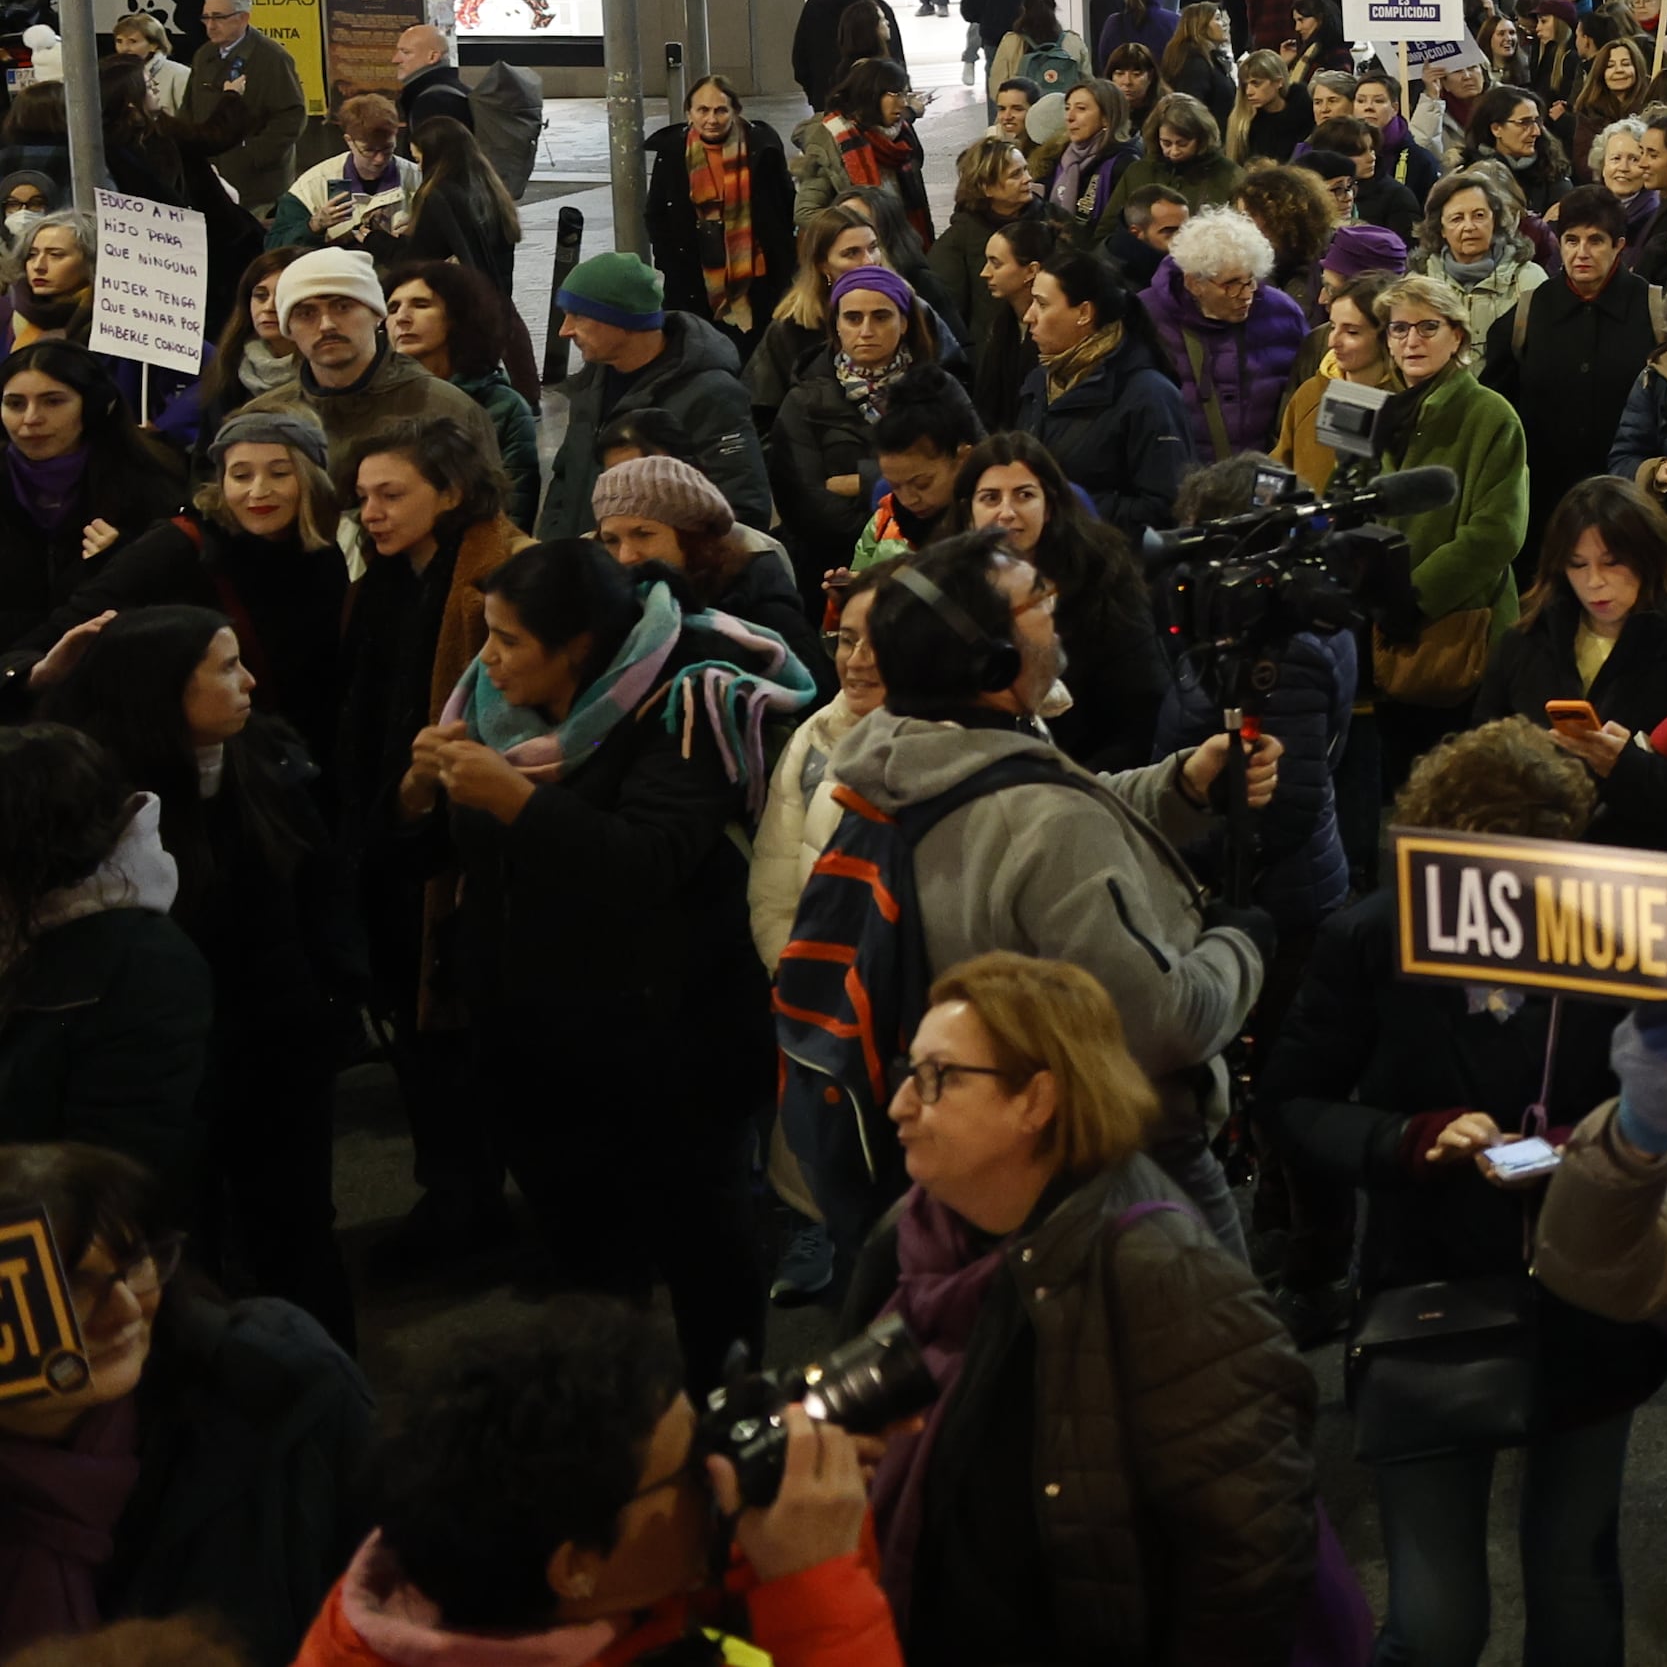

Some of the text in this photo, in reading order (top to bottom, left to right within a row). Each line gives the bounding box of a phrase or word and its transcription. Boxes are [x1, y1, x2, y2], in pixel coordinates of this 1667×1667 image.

[1372, 6, 1436, 19] COMPLICIDAD
[99, 192, 162, 218] EDUCO A
[146, 227, 183, 249] PARA
[104, 243, 130, 260] QUE
[101, 276, 196, 311] MUJER TENGA
[101, 298, 200, 337] QUE SANAR POR
[99, 321, 150, 346] HABERLE
[1424, 864, 1524, 961] LAS
